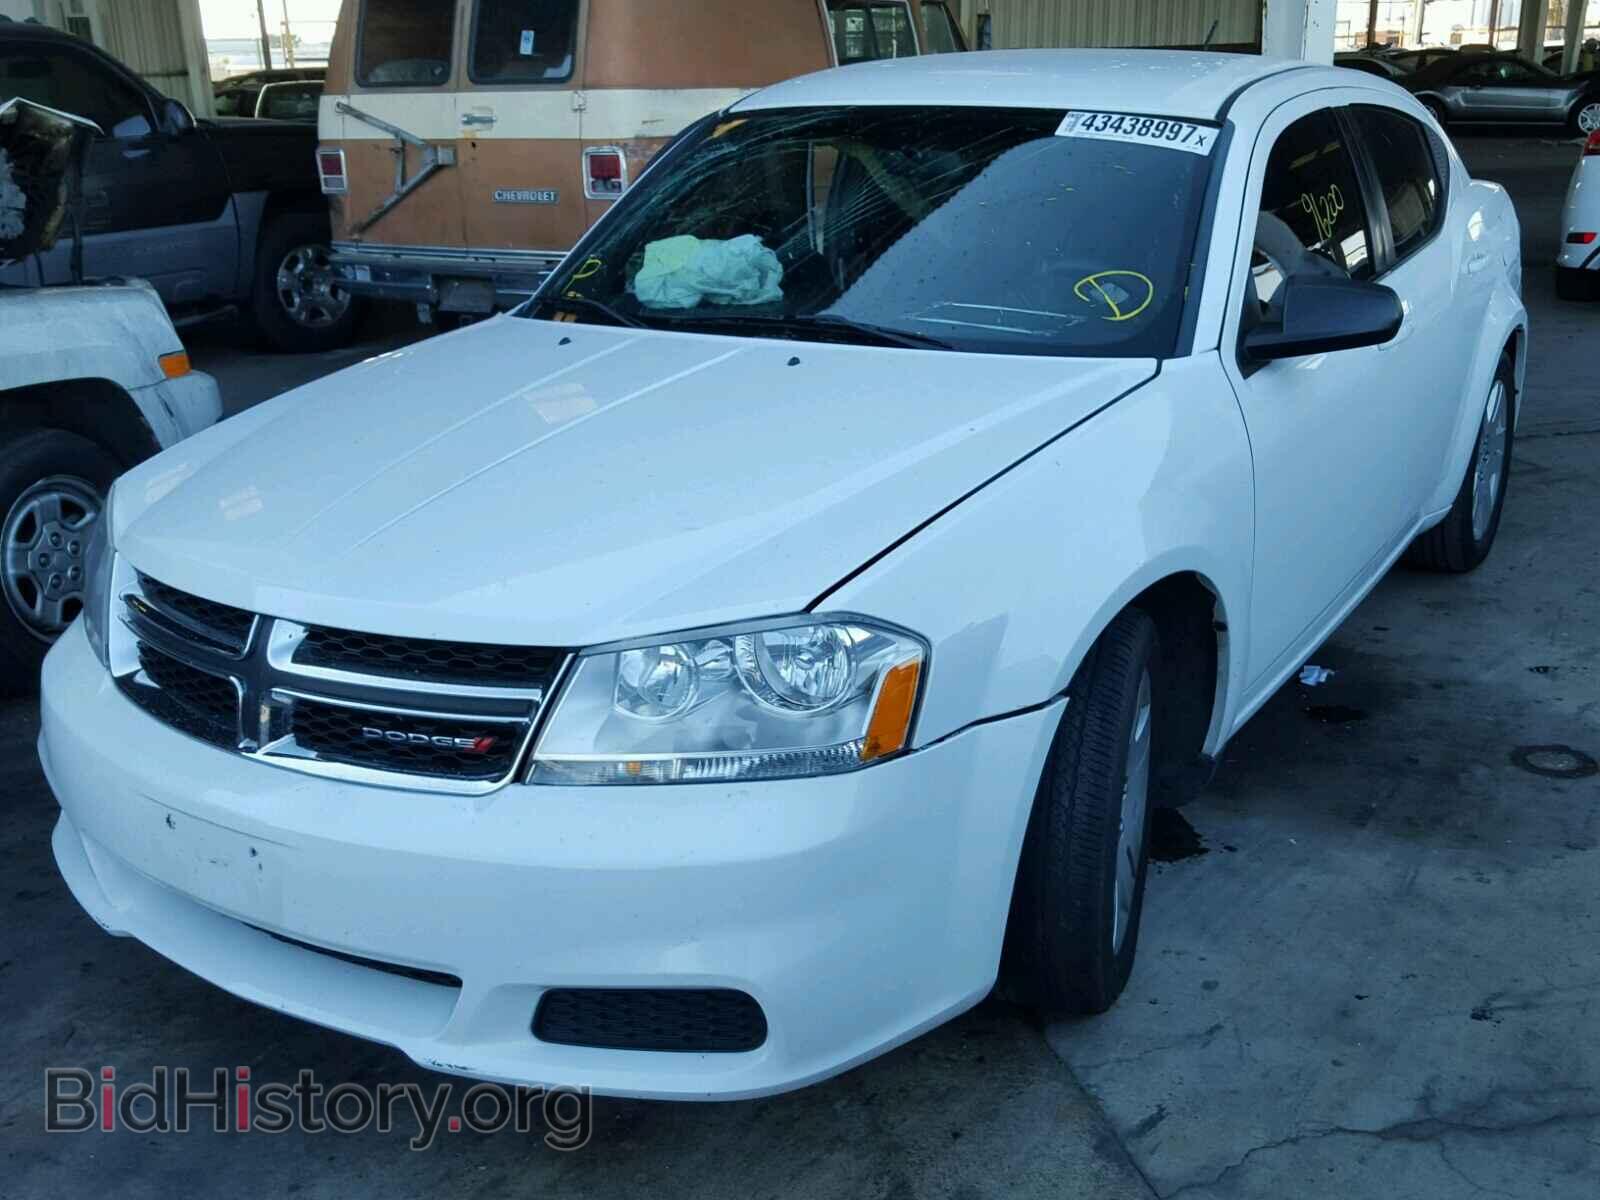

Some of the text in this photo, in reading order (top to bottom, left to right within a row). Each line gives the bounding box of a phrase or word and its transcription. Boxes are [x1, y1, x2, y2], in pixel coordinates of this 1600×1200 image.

[1081, 113, 1198, 144] 43438997
[494, 190, 556, 202] CHEVROLET
[362, 727, 476, 749] DODGE
